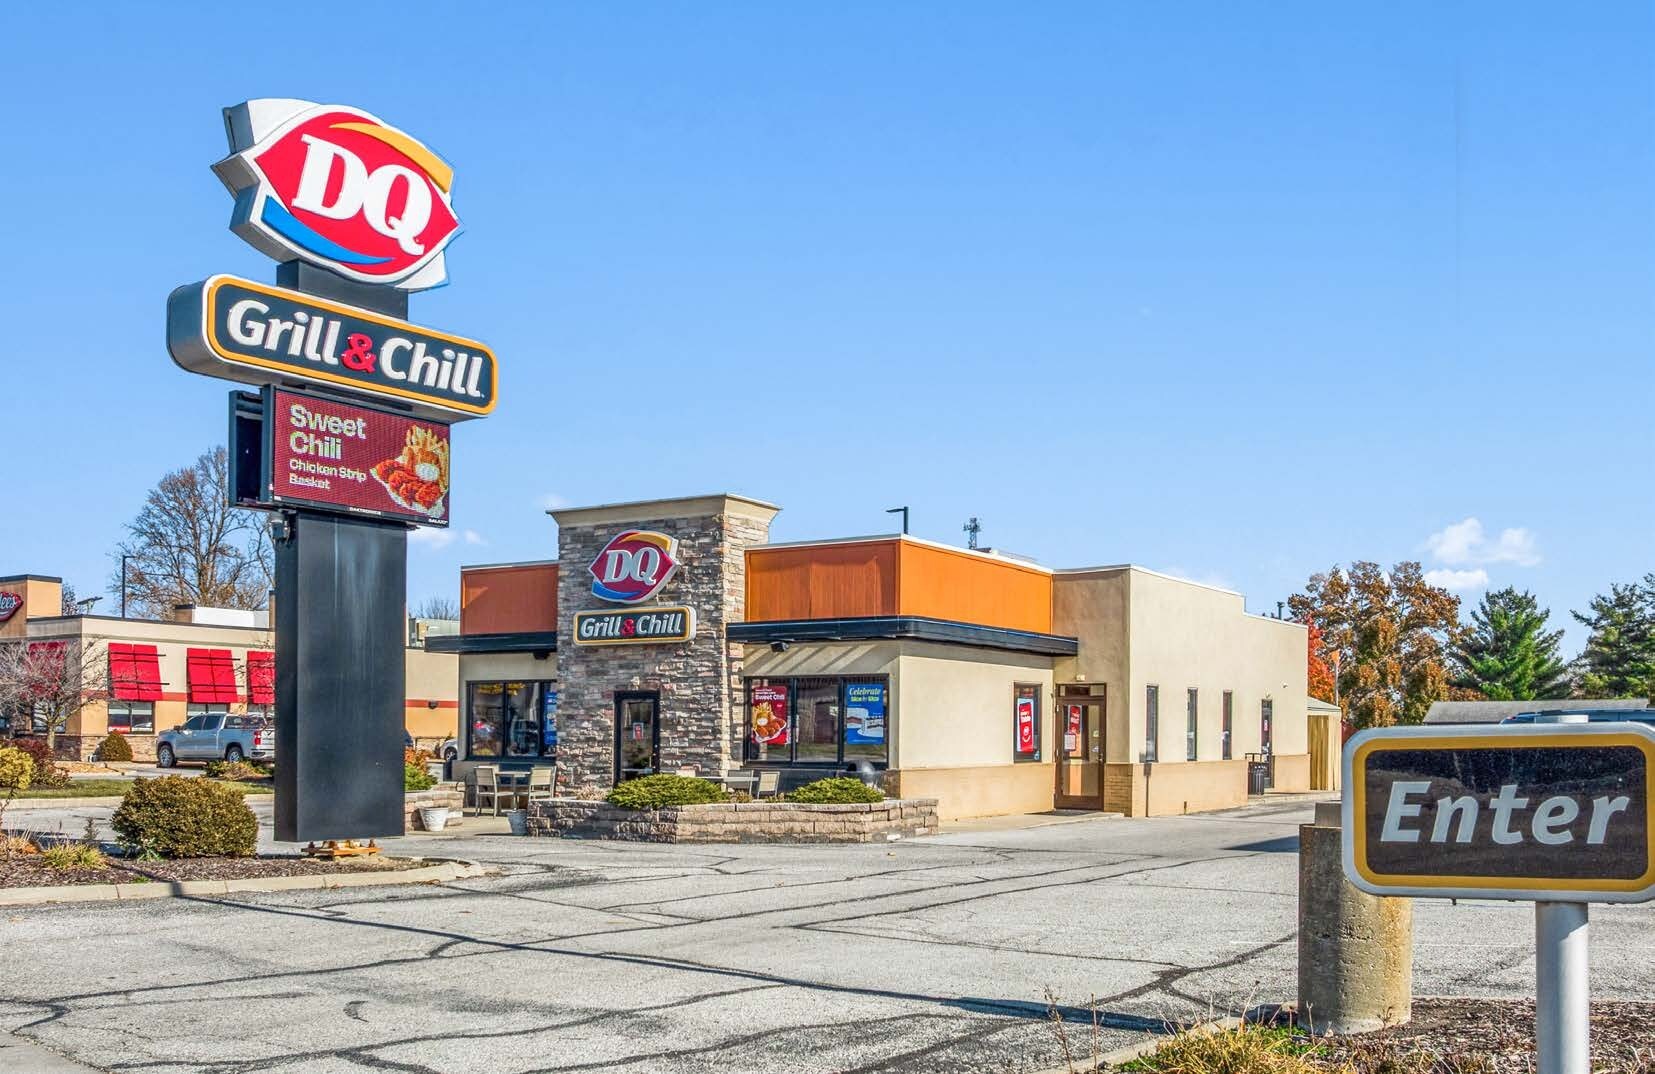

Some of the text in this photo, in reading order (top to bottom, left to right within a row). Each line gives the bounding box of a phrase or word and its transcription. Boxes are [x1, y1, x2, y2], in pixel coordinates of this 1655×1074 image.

[291, 133, 432, 256] DQ
[290, 404, 366, 439] Sweet
[290, 430, 341, 459] Chili
[289, 458, 367, 482] Chicken Strip
[289, 473, 330, 489] Basket
[602, 547, 660, 586] DQ
[849, 687, 881, 695] Celebrate
[1380, 781, 1630, 845] Enter
